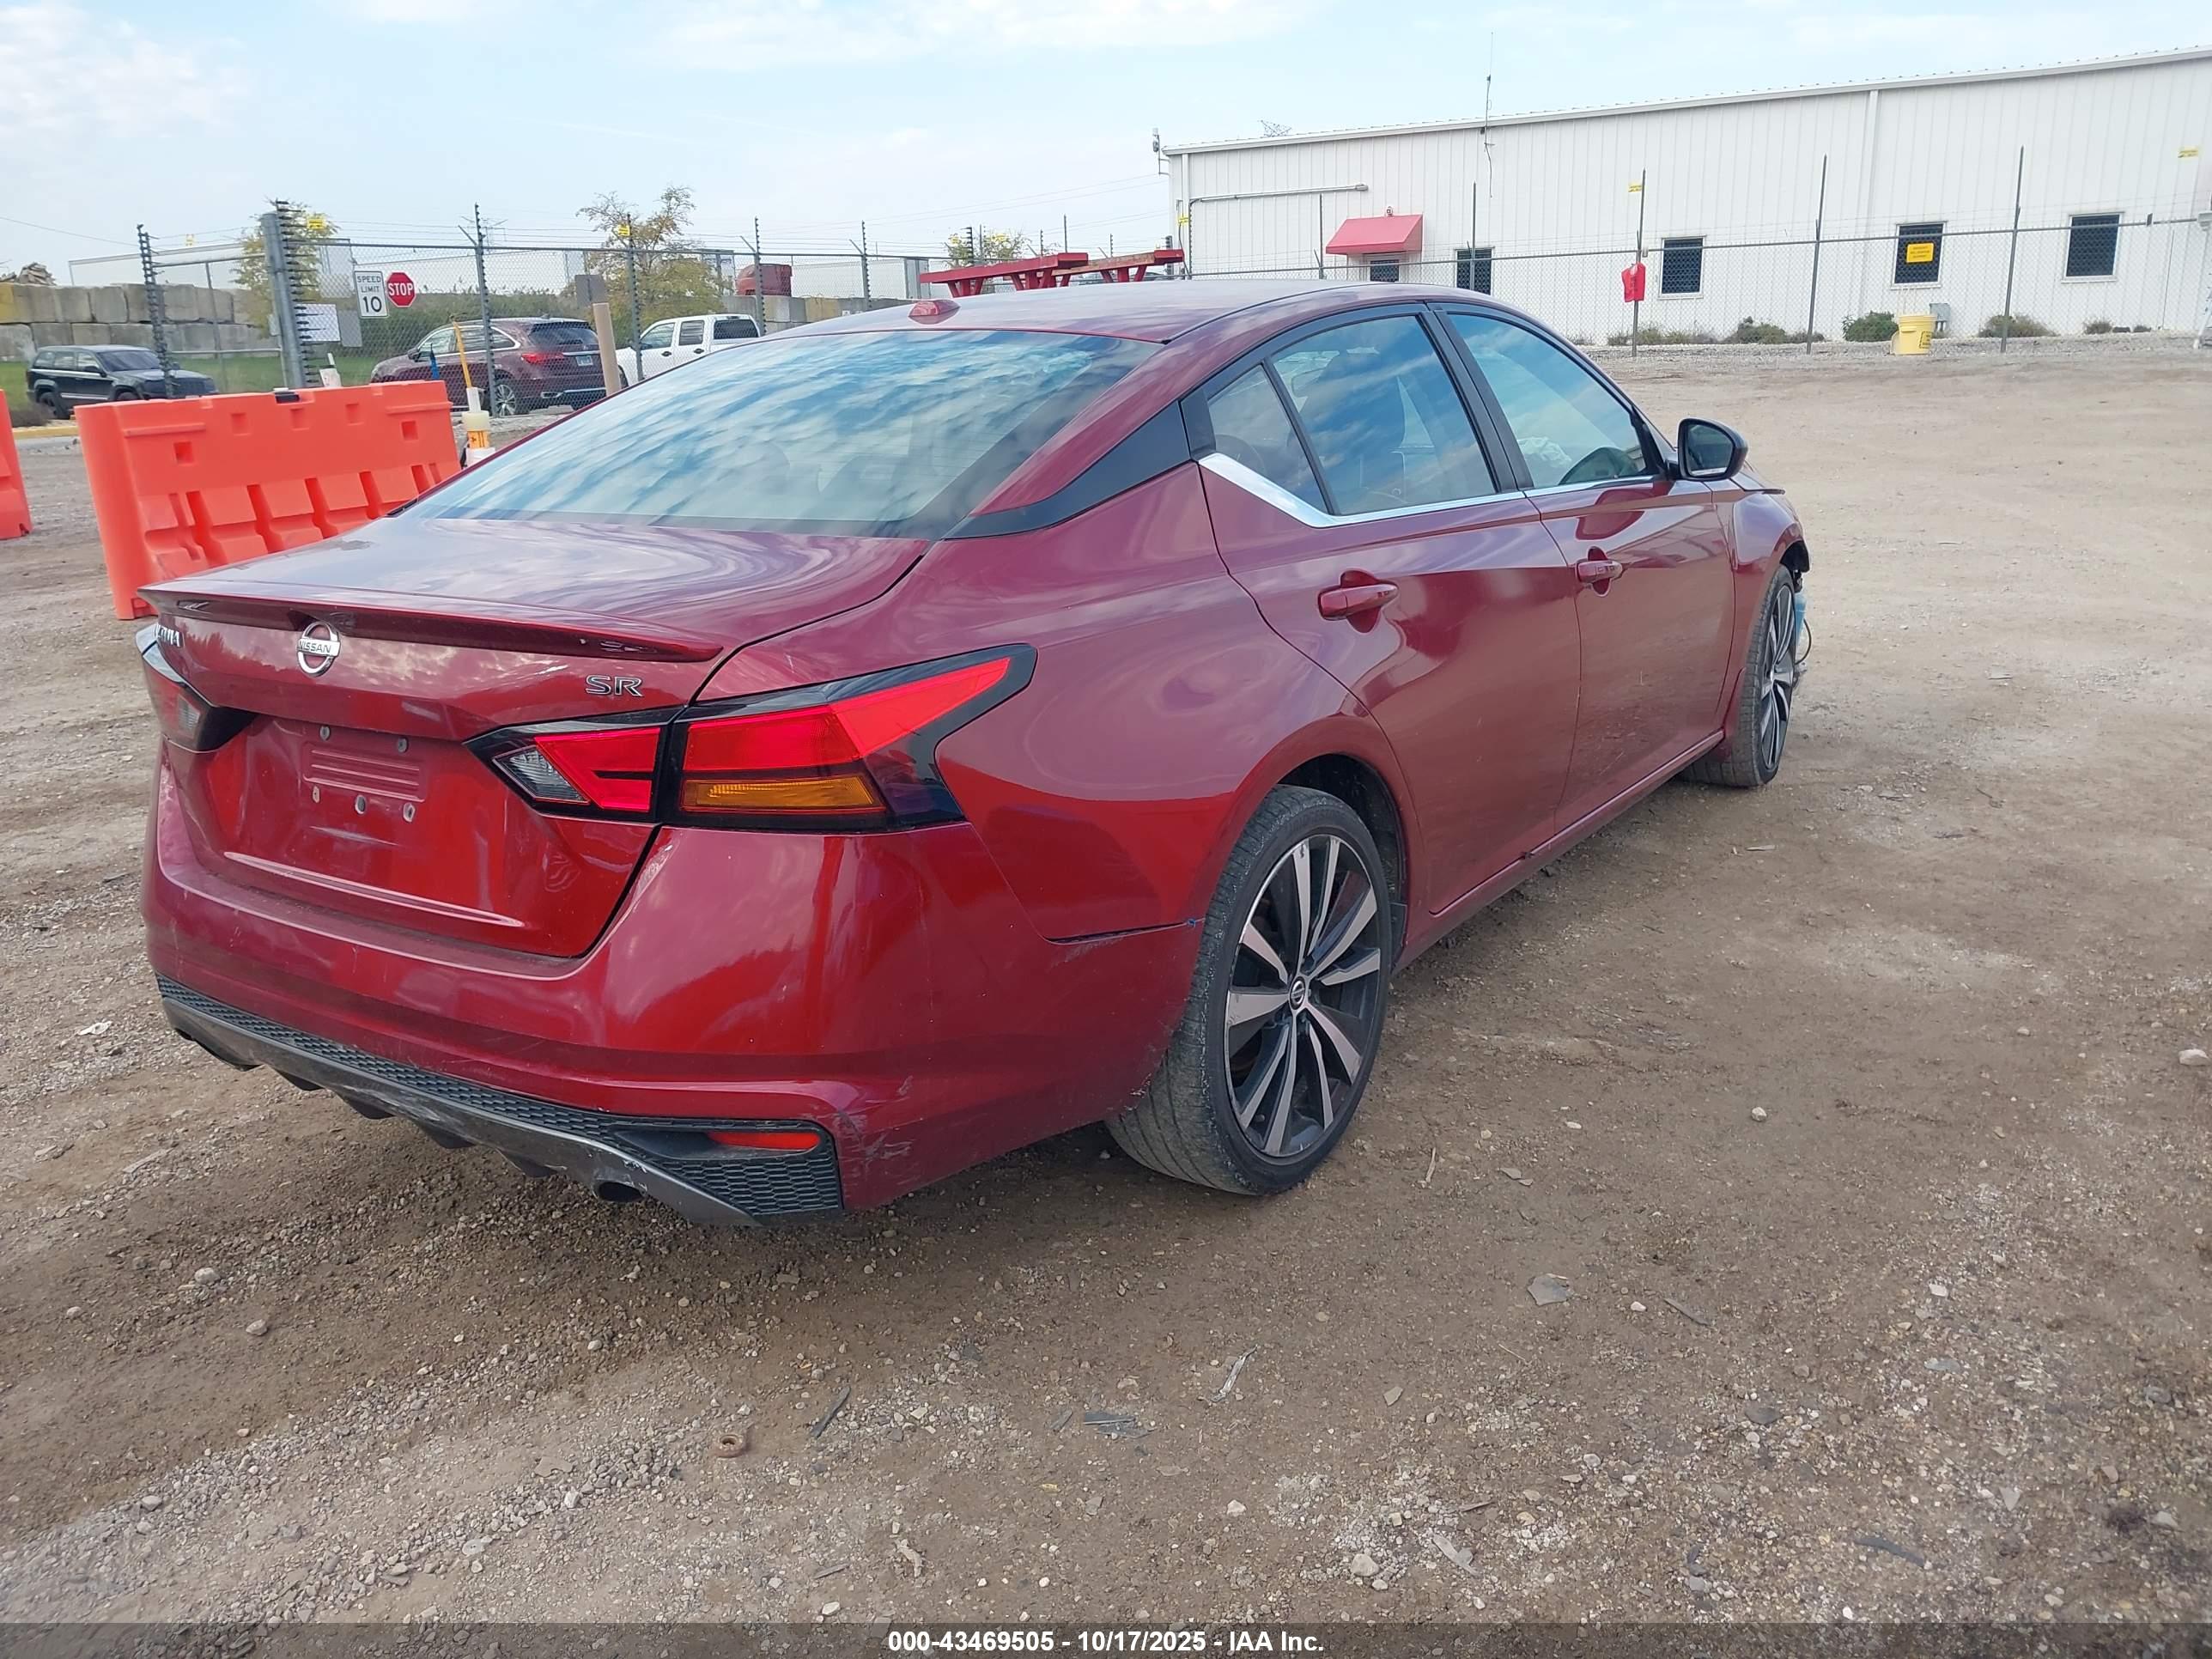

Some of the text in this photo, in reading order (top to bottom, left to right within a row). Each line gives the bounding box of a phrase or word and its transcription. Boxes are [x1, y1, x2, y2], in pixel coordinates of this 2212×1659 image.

[387, 283, 413, 296] STOP
[362, 295, 382, 313] 10
[299, 640, 331, 653] NISSAN
[585, 674, 645, 697] SR
